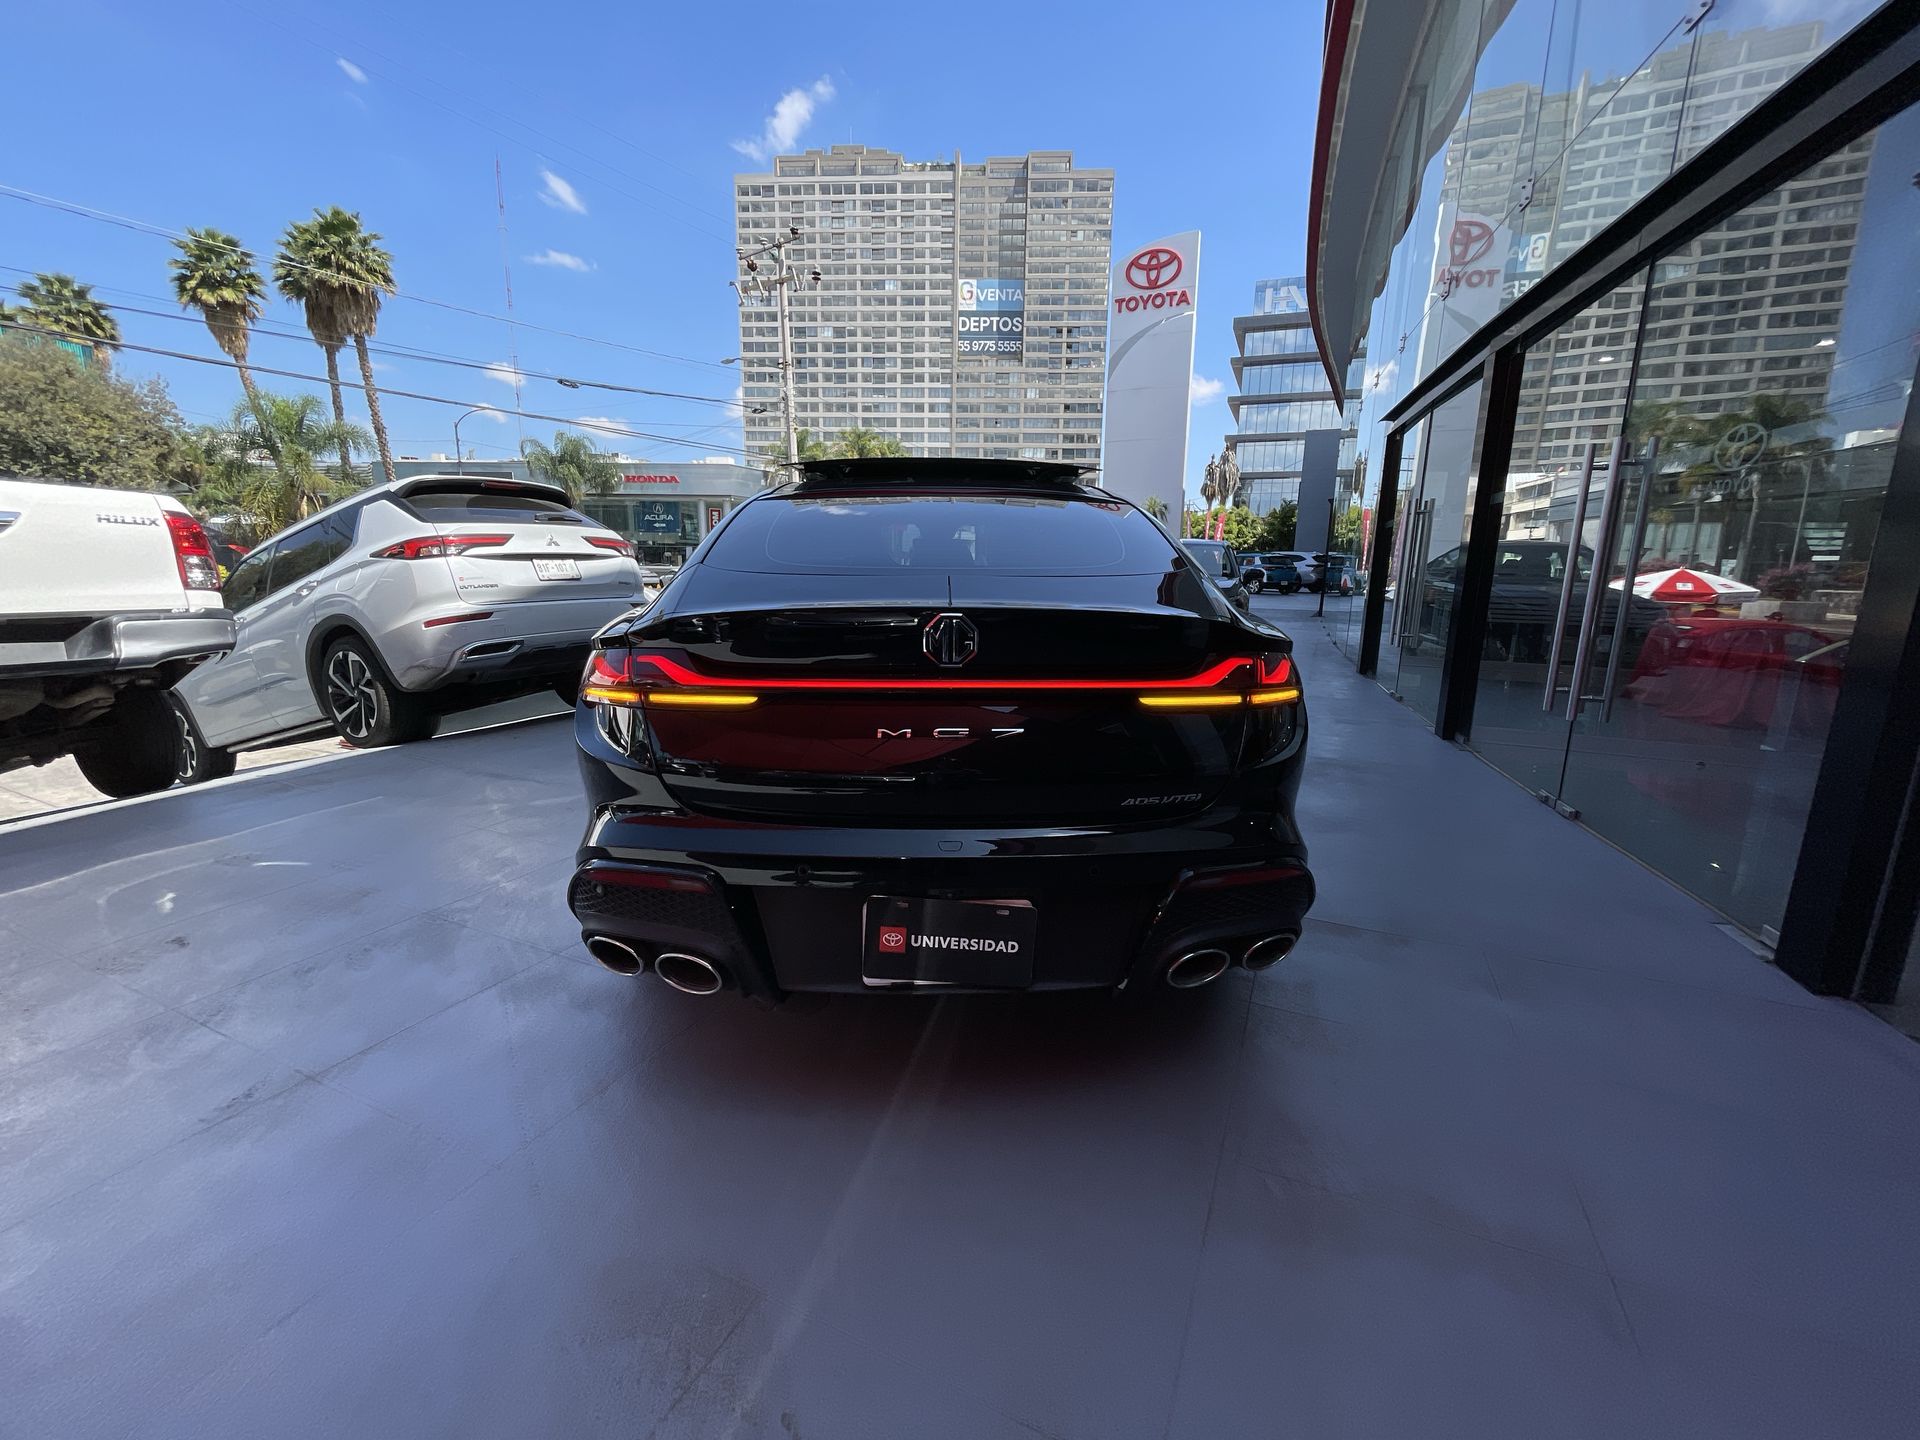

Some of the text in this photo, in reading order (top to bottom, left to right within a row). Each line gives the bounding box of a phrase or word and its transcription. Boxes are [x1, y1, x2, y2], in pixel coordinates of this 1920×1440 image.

[977, 288, 1023, 301] VENTA
[1114, 290, 1191, 313] TOYOTA
[958, 316, 1023, 332] DEPTOS
[958, 340, 1022, 352] 55 9775 5555
[623, 475, 680, 484] HONDA
[96, 513, 160, 527] HILUX
[928, 618, 974, 663] MG
[910, 934, 1019, 953] UNIVERSIDAD
